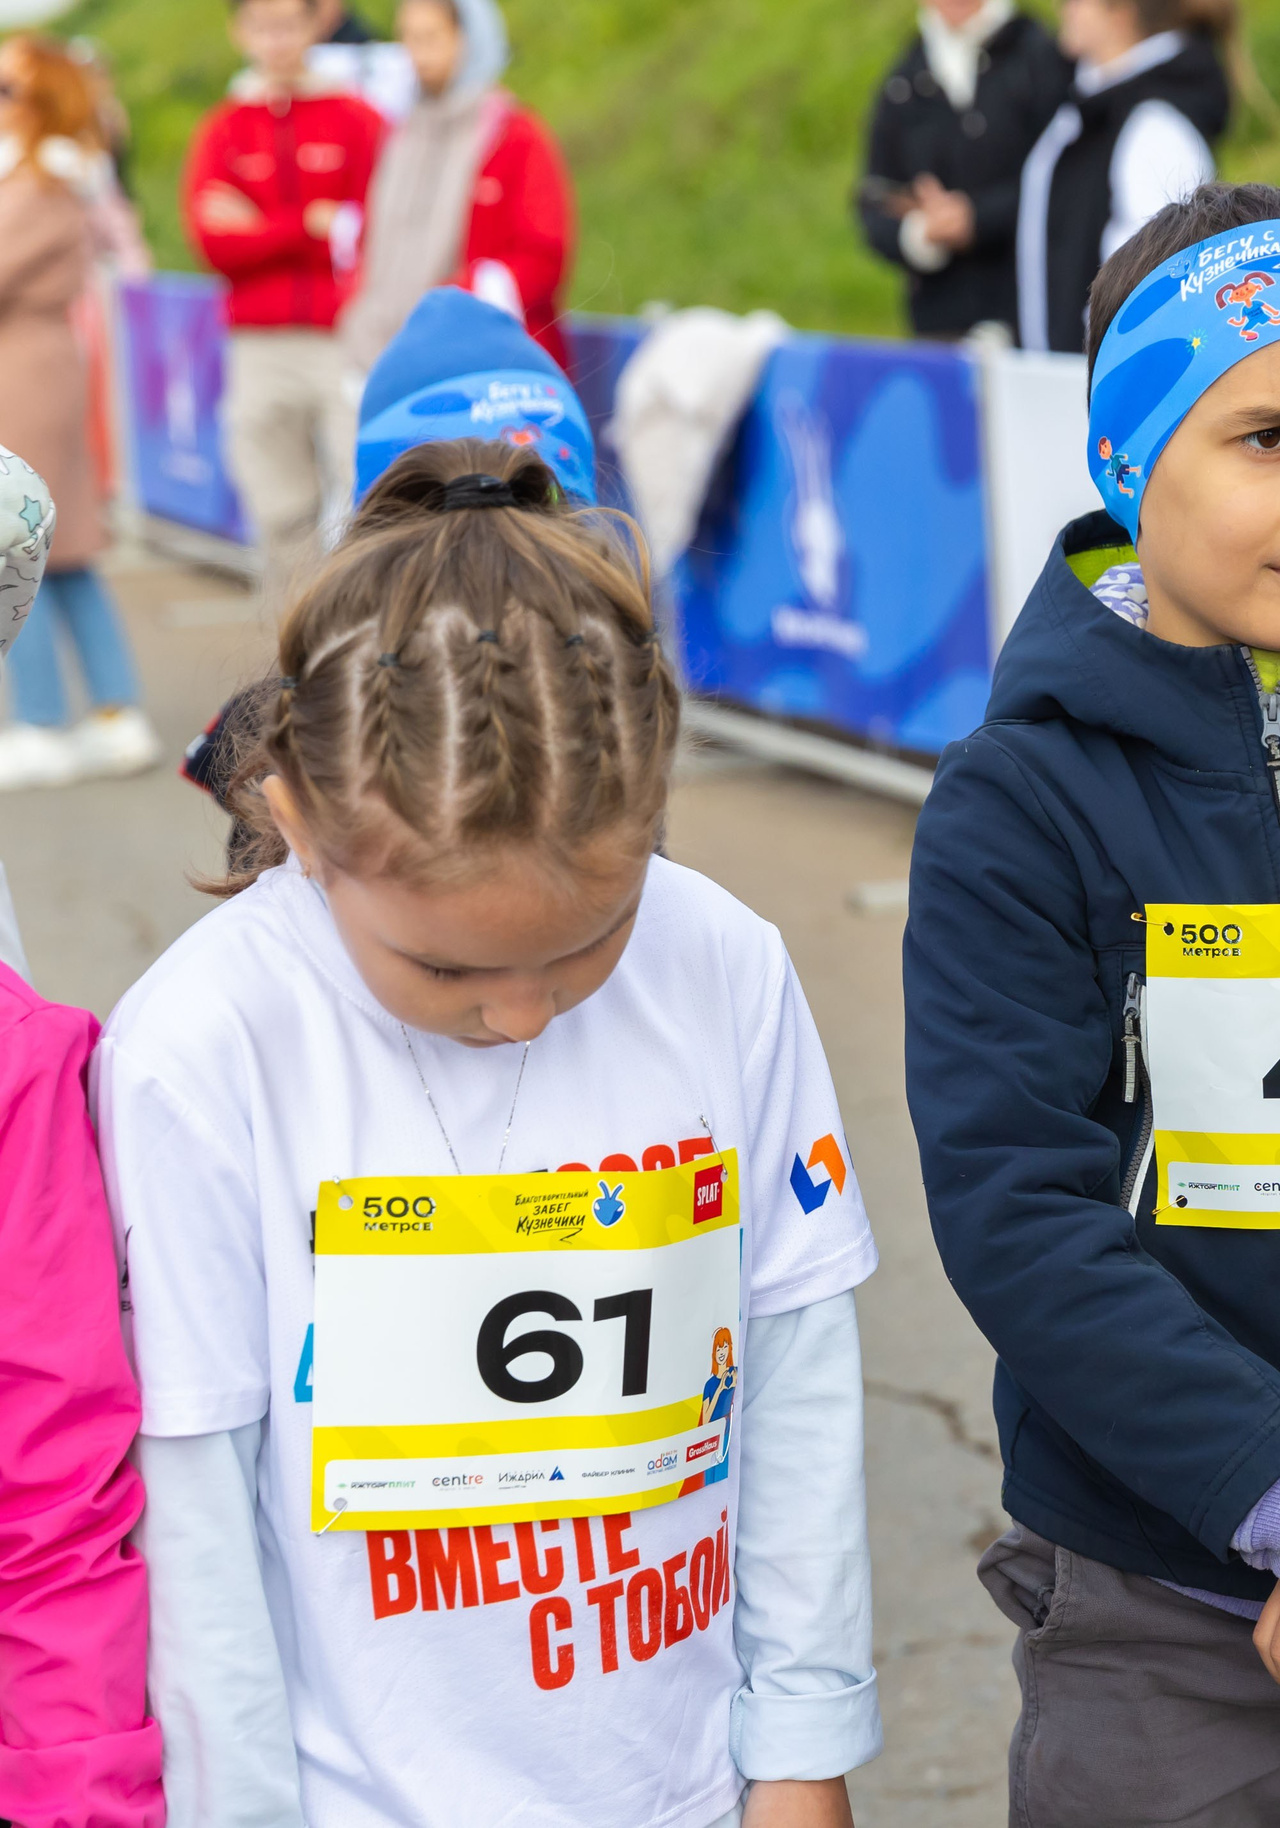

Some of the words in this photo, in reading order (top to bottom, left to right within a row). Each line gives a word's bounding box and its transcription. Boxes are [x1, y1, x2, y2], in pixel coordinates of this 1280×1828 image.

[1181, 924, 1243, 945] 500
[1183, 947, 1241, 959] метров
[697, 1181, 719, 1207] SPLAT
[363, 1196, 436, 1218] 500
[533, 1202, 571, 1216] ЗАБЕГ
[364, 1222, 434, 1234] метров
[476, 1288, 654, 1404] 61
[432, 1473, 484, 1487] centre
[366, 1511, 641, 1621] ВМЕСТЕ
[529, 1596, 575, 1691] С
[586, 1504, 731, 1675] ТОБОЙ
